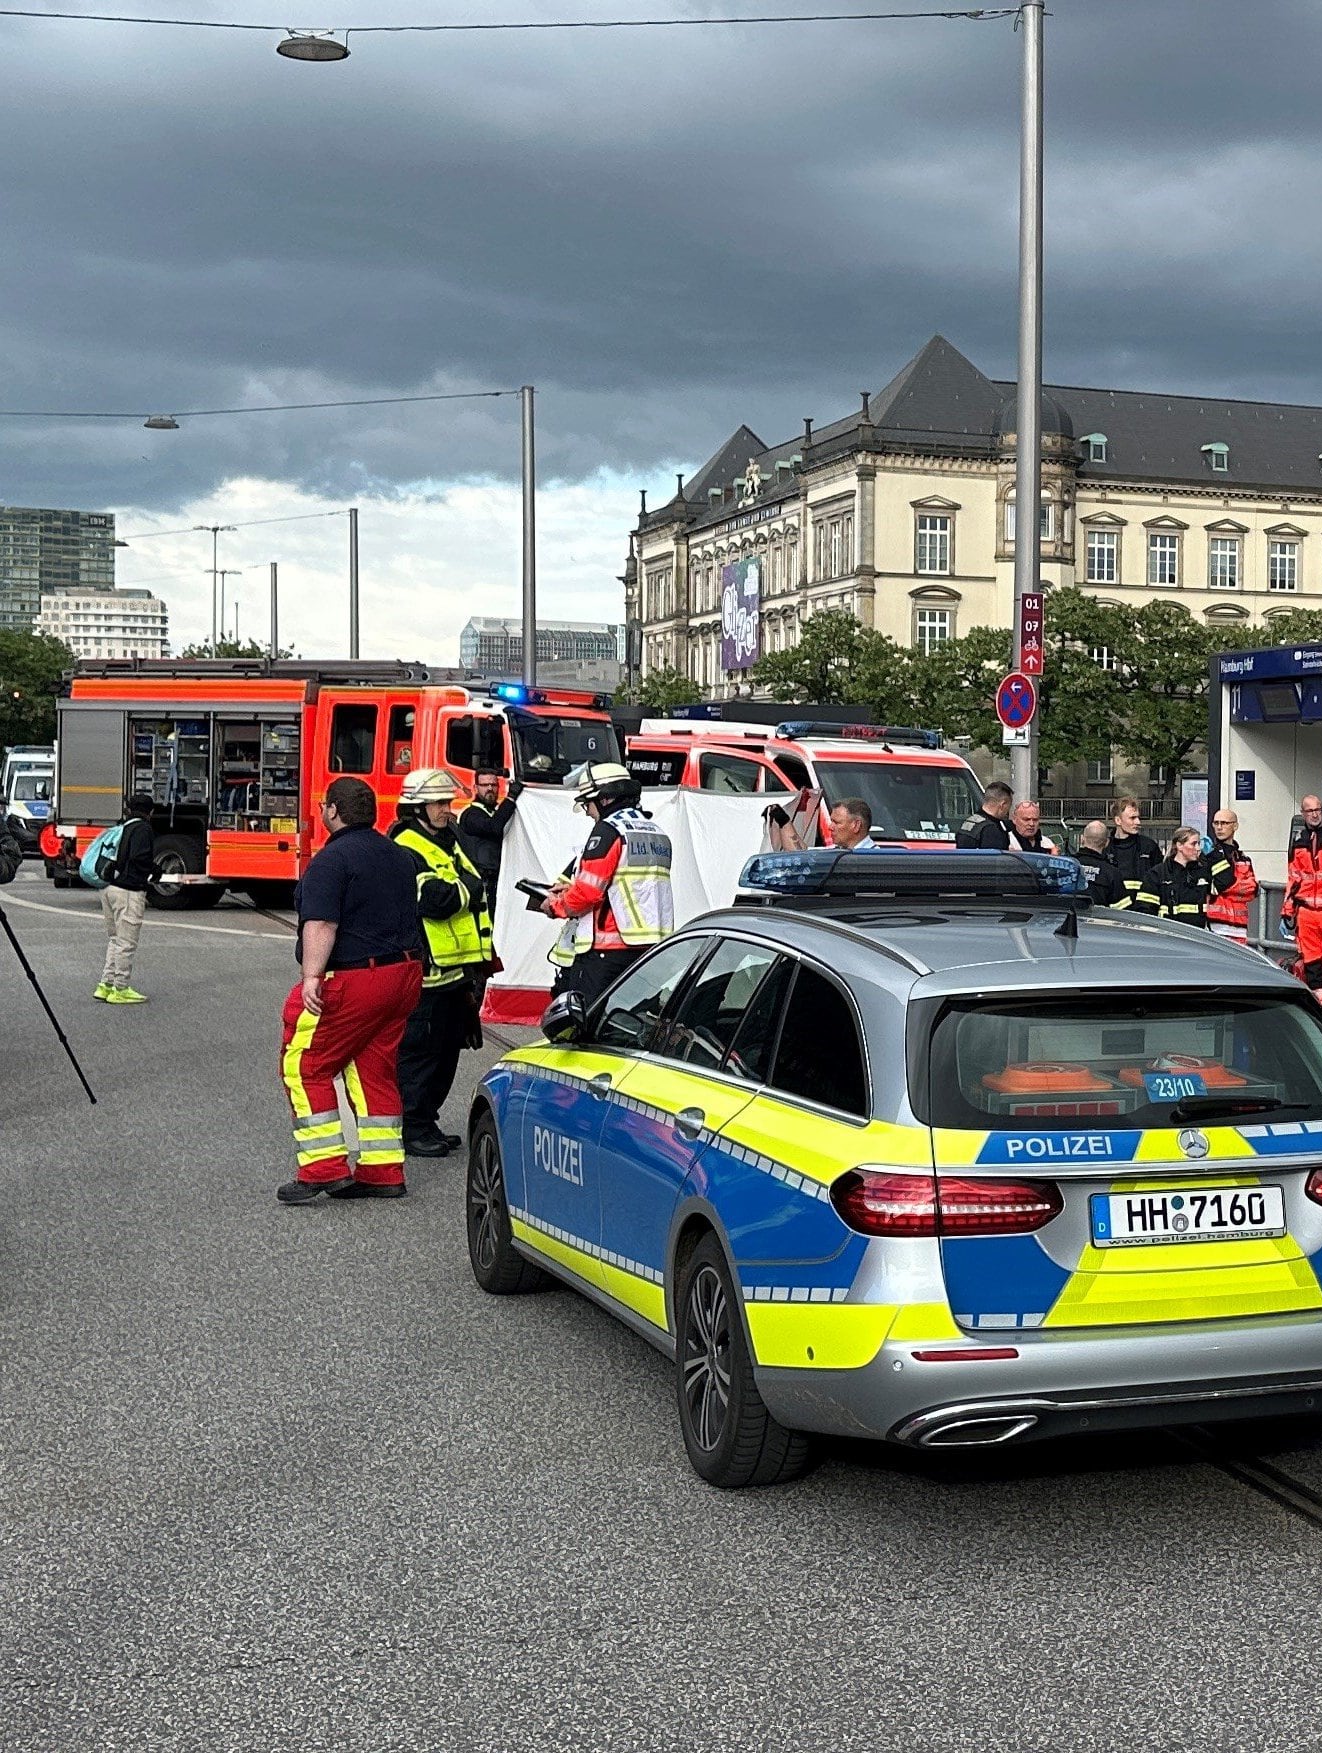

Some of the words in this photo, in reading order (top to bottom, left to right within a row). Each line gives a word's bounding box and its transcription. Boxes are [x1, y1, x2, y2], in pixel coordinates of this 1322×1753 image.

[1025, 598, 1039, 610] 01
[1025, 620, 1039, 632] 07
[1232, 685, 1241, 714] 11
[587, 737, 596, 750] 6
[1155, 1077, 1195, 1098] 23/10
[534, 1125, 584, 1187] POLIZEI
[1006, 1136, 1113, 1158] POLIZEI
[1126, 1197, 1169, 1233] HH
[1189, 1192, 1266, 1229] 7160
[1098, 1222, 1106, 1233] D
